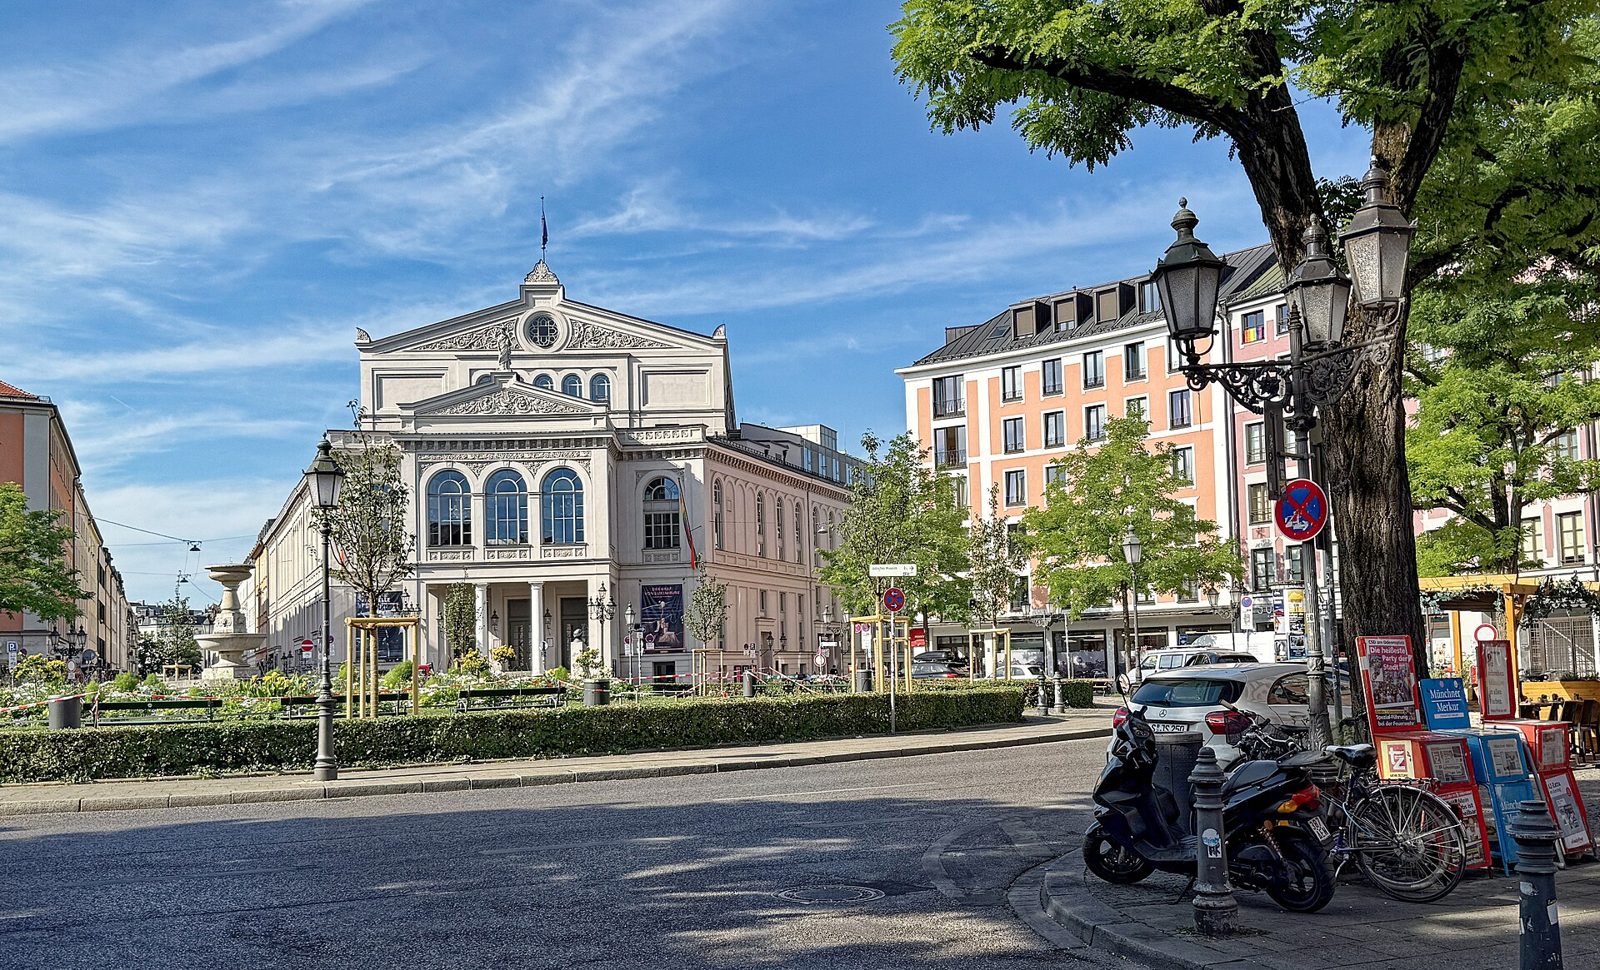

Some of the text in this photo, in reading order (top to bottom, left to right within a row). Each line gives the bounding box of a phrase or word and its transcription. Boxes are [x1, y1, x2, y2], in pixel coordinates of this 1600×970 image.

[10, 643, 15, 651] P
[1381, 646, 1406, 654] heißeste
[1381, 654, 1397, 663] Party
[1430, 688, 1460, 699] Münchner
[1436, 702, 1459, 712] Merkur
[1389, 747, 1405, 770] tz
